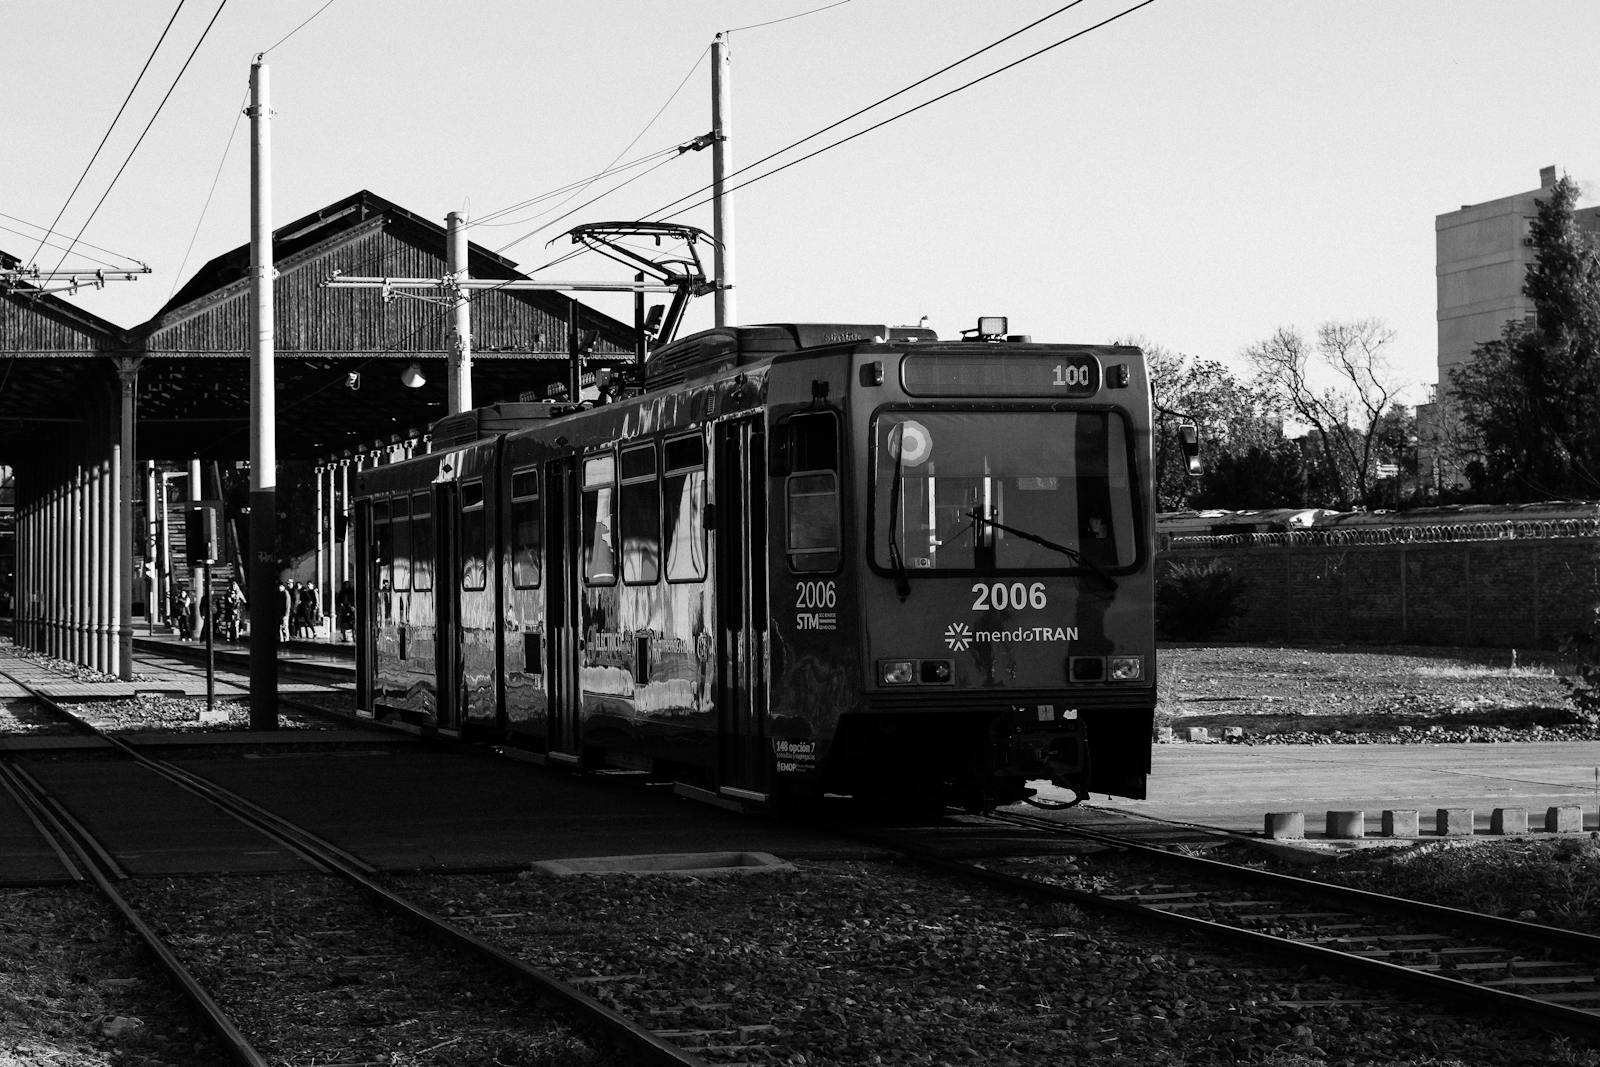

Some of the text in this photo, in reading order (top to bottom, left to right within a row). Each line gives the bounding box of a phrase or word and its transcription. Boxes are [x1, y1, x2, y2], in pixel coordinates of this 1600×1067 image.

[1052, 364, 1089, 386] 100
[796, 581, 836, 608] 2006
[971, 582, 1047, 611] 2006
[796, 613, 819, 630] STM
[975, 627, 1079, 642] mendoTRAN
